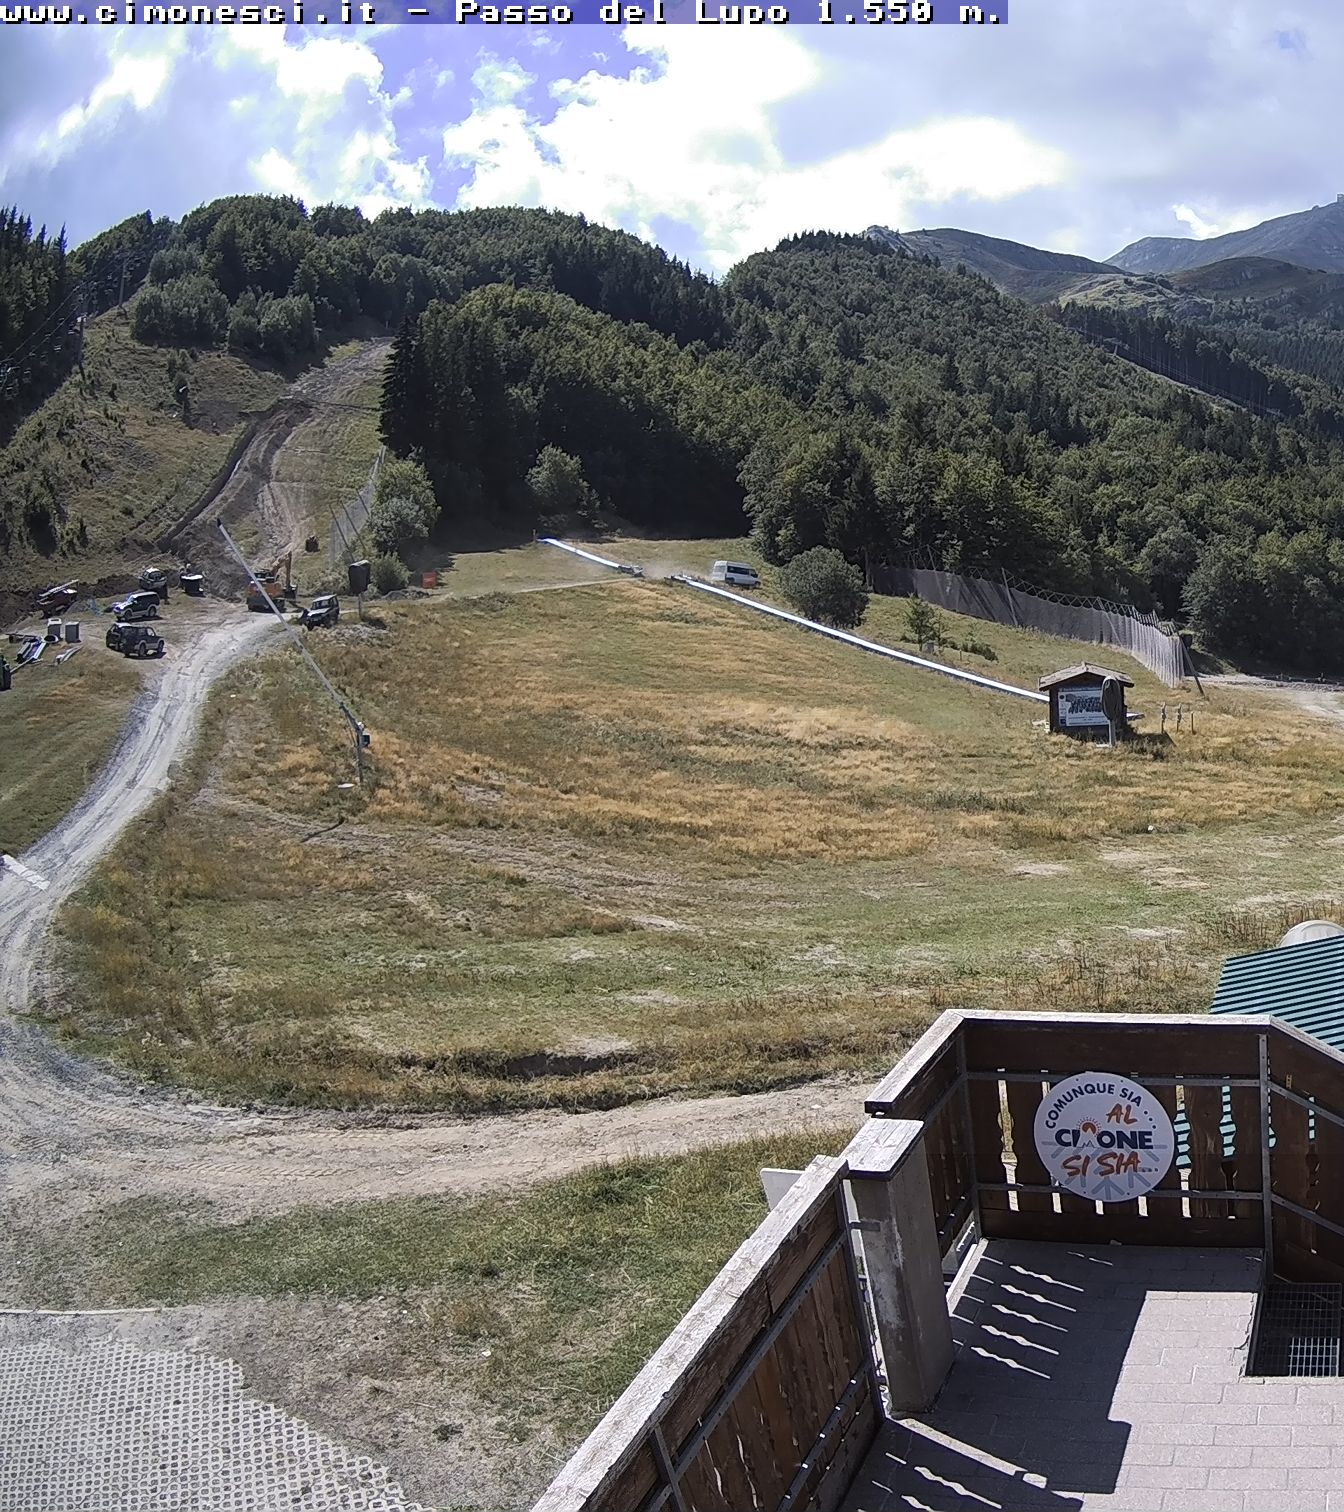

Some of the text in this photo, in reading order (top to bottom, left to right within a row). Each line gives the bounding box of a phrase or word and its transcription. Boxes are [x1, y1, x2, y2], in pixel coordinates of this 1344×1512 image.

[1045, 1083, 1116, 1129] COMUNQUE
[1106, 1103, 1138, 1125] AL
[1054, 1126, 1154, 1150] CIMONE
[1062, 1154, 1091, 1177] SI
